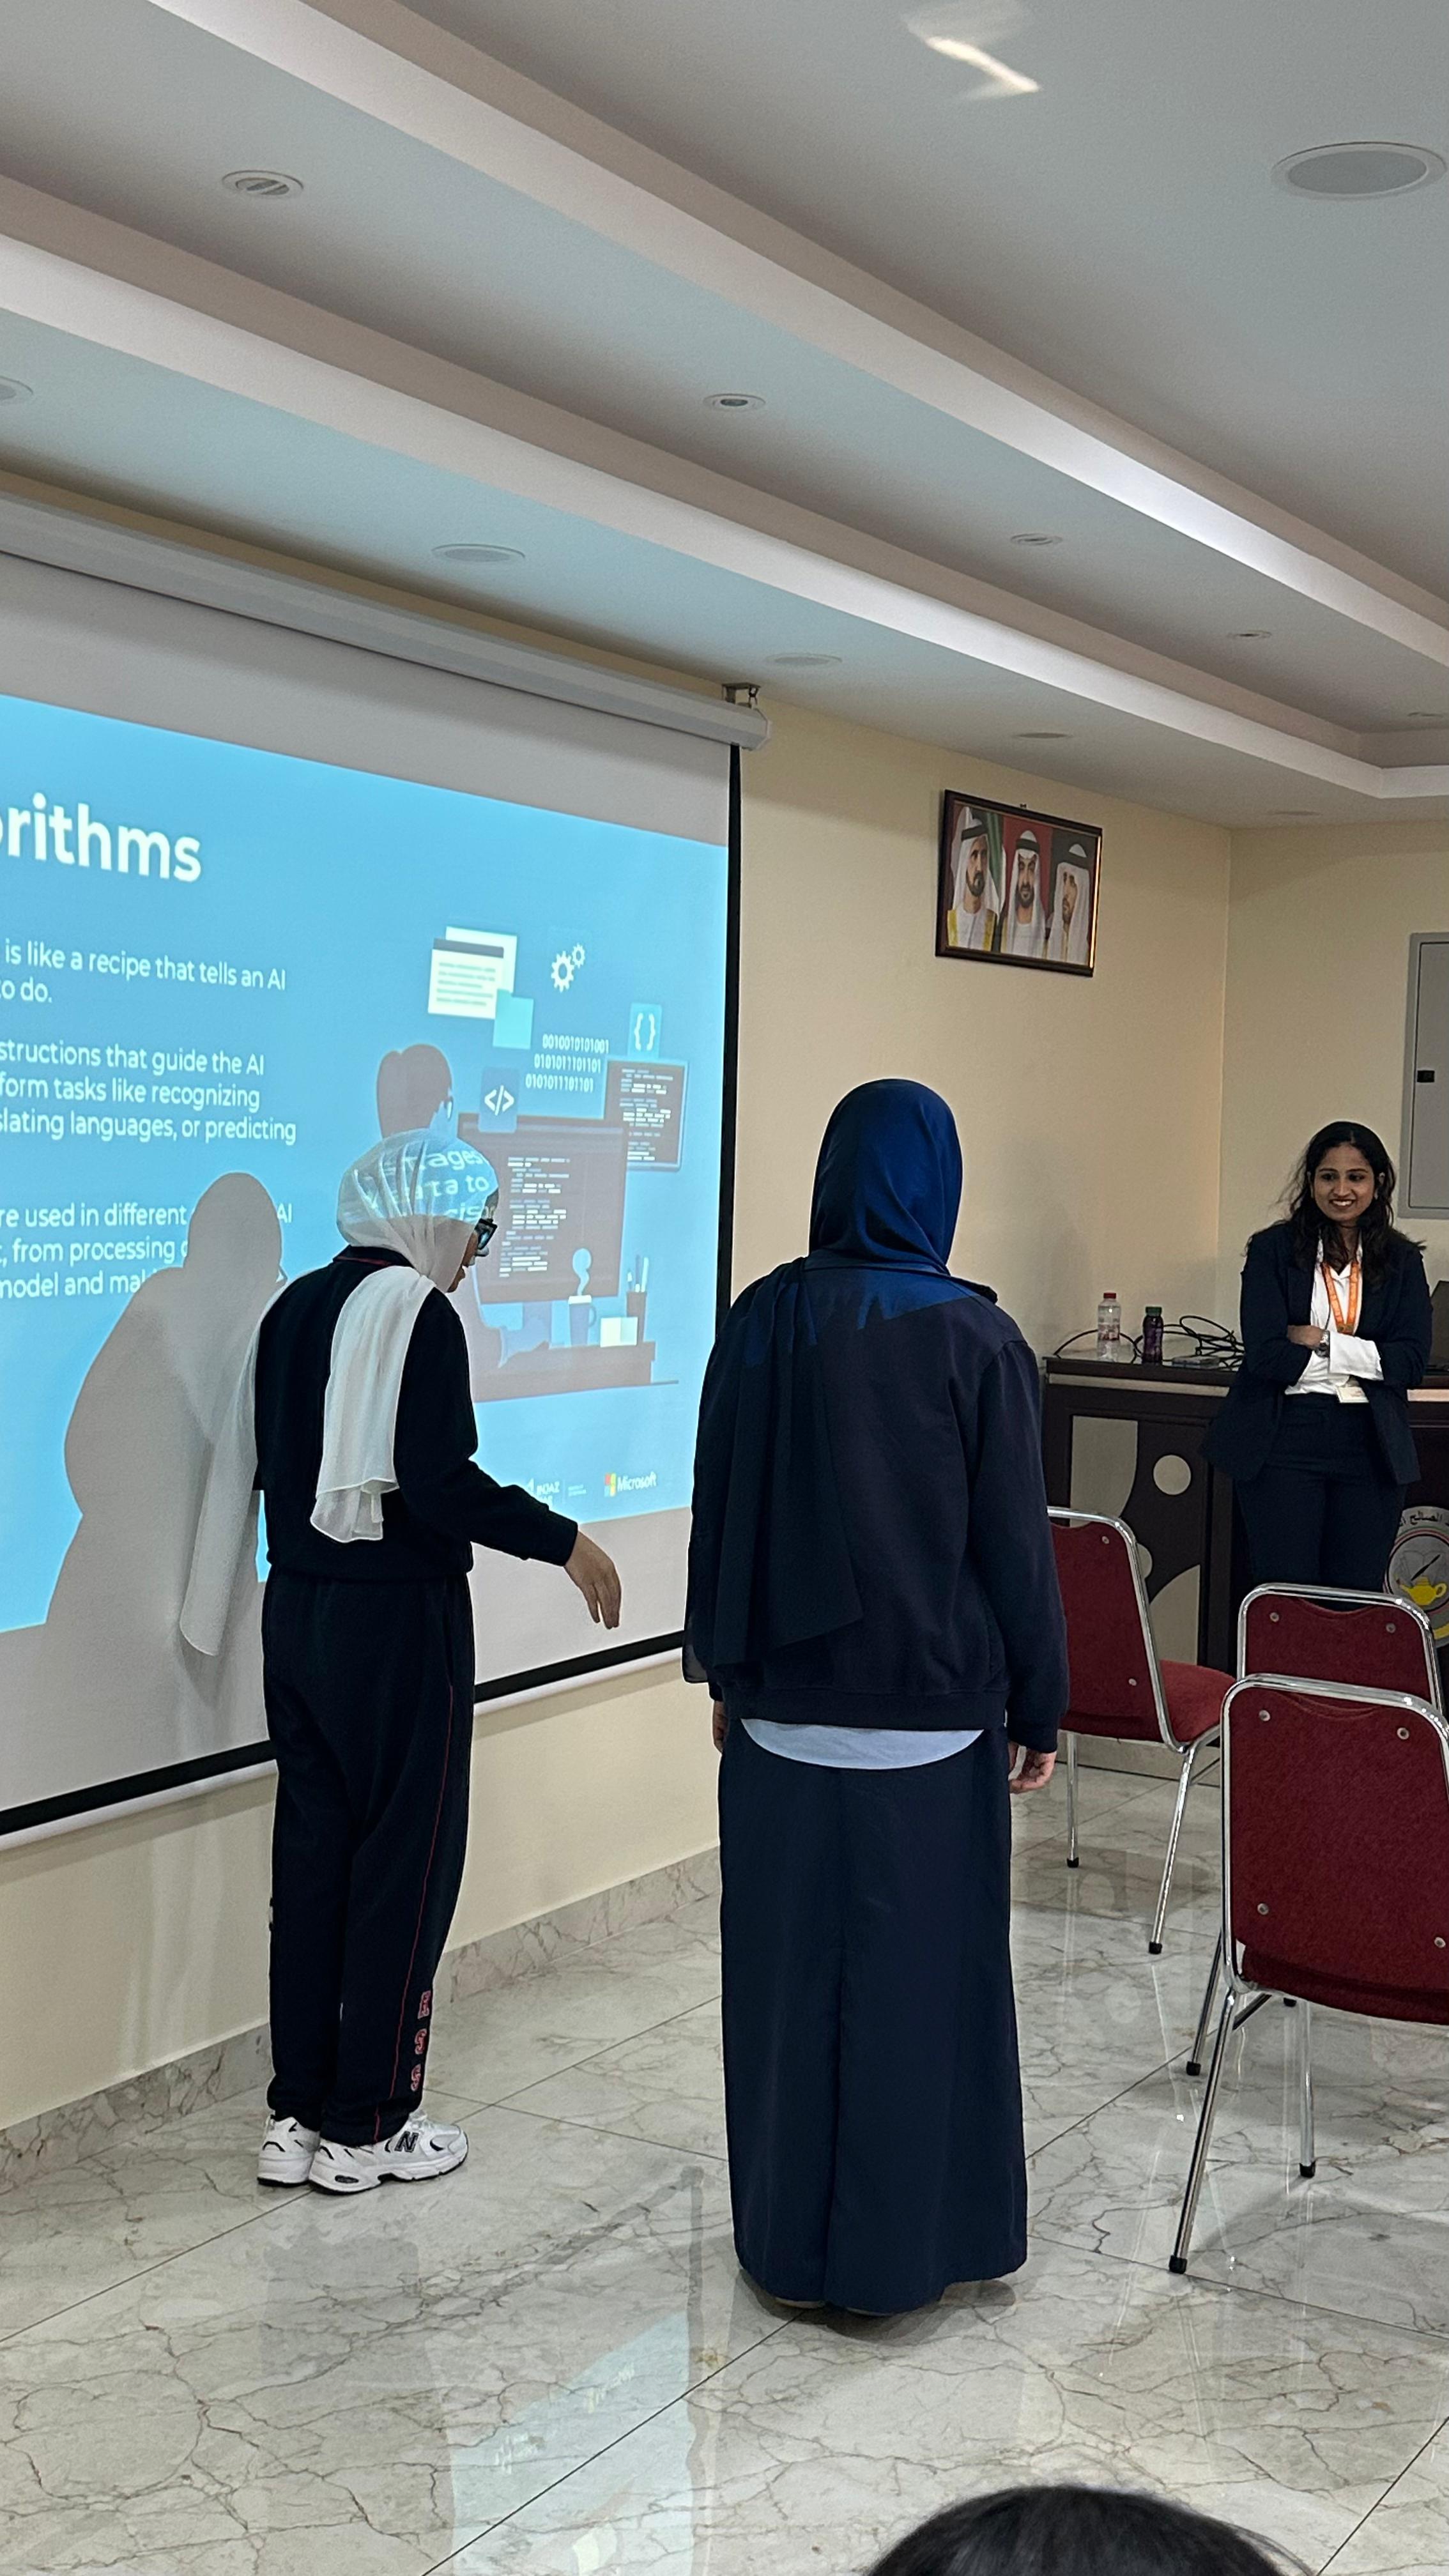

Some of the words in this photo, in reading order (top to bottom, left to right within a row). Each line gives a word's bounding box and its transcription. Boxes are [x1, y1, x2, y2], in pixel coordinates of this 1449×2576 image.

[0, 793, 201, 882] rithms
[6, 939, 21, 965] is
[28, 941, 65, 969] like
[71, 952, 82, 970] a
[89, 951, 150, 980] recipe
[155, 955, 194, 981] that
[199, 962, 236, 985] tells
[241, 970, 263, 988] an
[268, 969, 285, 990] AI
[0, 981, 15, 999] o
[20, 977, 52, 1002] do.
[106, 1044, 147, 1069] that
[152, 1048, 207, 1076] guide
[212, 1051, 241, 1073] the
[247, 1054, 263, 1075] AI
[54, 1077, 106, 1101] tasks
[112, 1078, 146, 1103] like
[152, 1084, 259, 1113] recognizing
[71, 1111, 177, 1142] languages,
[182, 1120, 200, 1137] or
[206, 1117, 296, 1146] predicting
[465, 1174, 489, 1193] to
[26, 1203, 74, 1227] used
[81, 1203, 98, 1227] in
[105, 1202, 186, 1225] different
[277, 1204, 291, 1223] AI
[13, 1238, 63, 1262] from
[70, 1236, 174, 1266] processing
[65, 1270, 103, 1296] and
[618, 1471, 657, 1491] Microsoft
